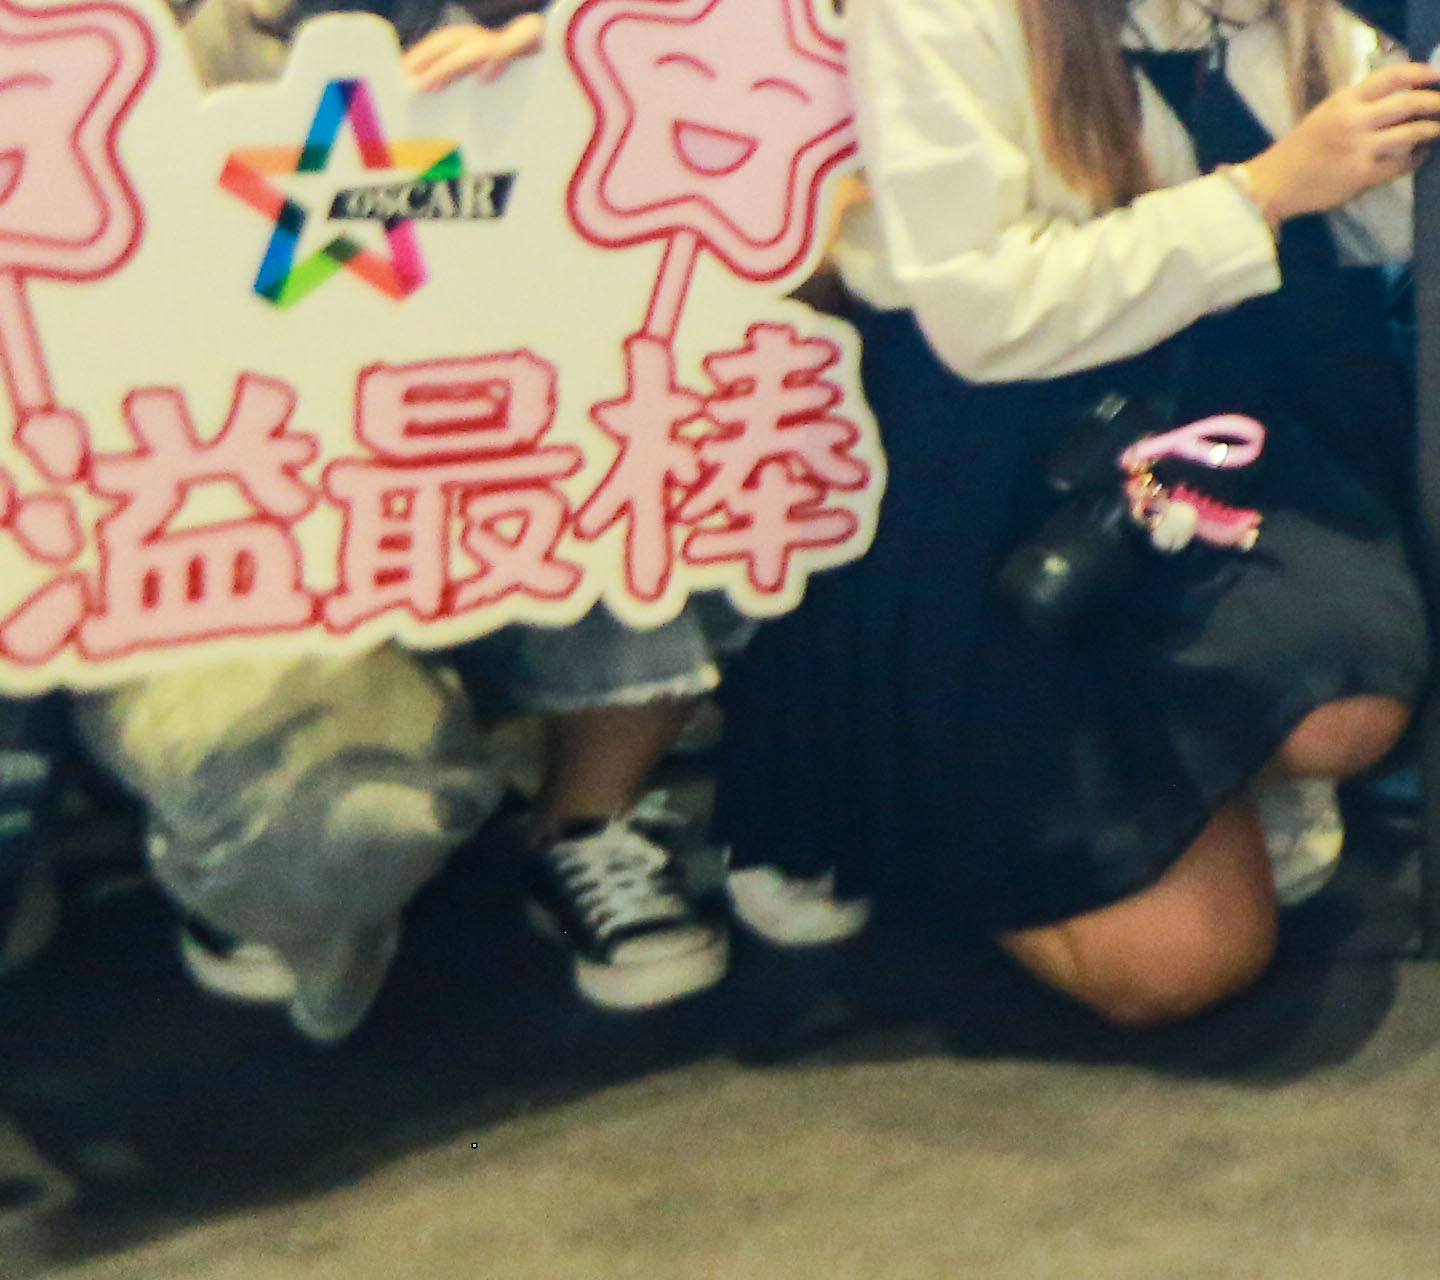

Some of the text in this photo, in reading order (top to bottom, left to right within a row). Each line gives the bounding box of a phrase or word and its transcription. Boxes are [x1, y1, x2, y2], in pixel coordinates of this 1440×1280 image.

[342, 175, 498, 220] OSCAR
[0, 322, 869, 664] 溢最棒
